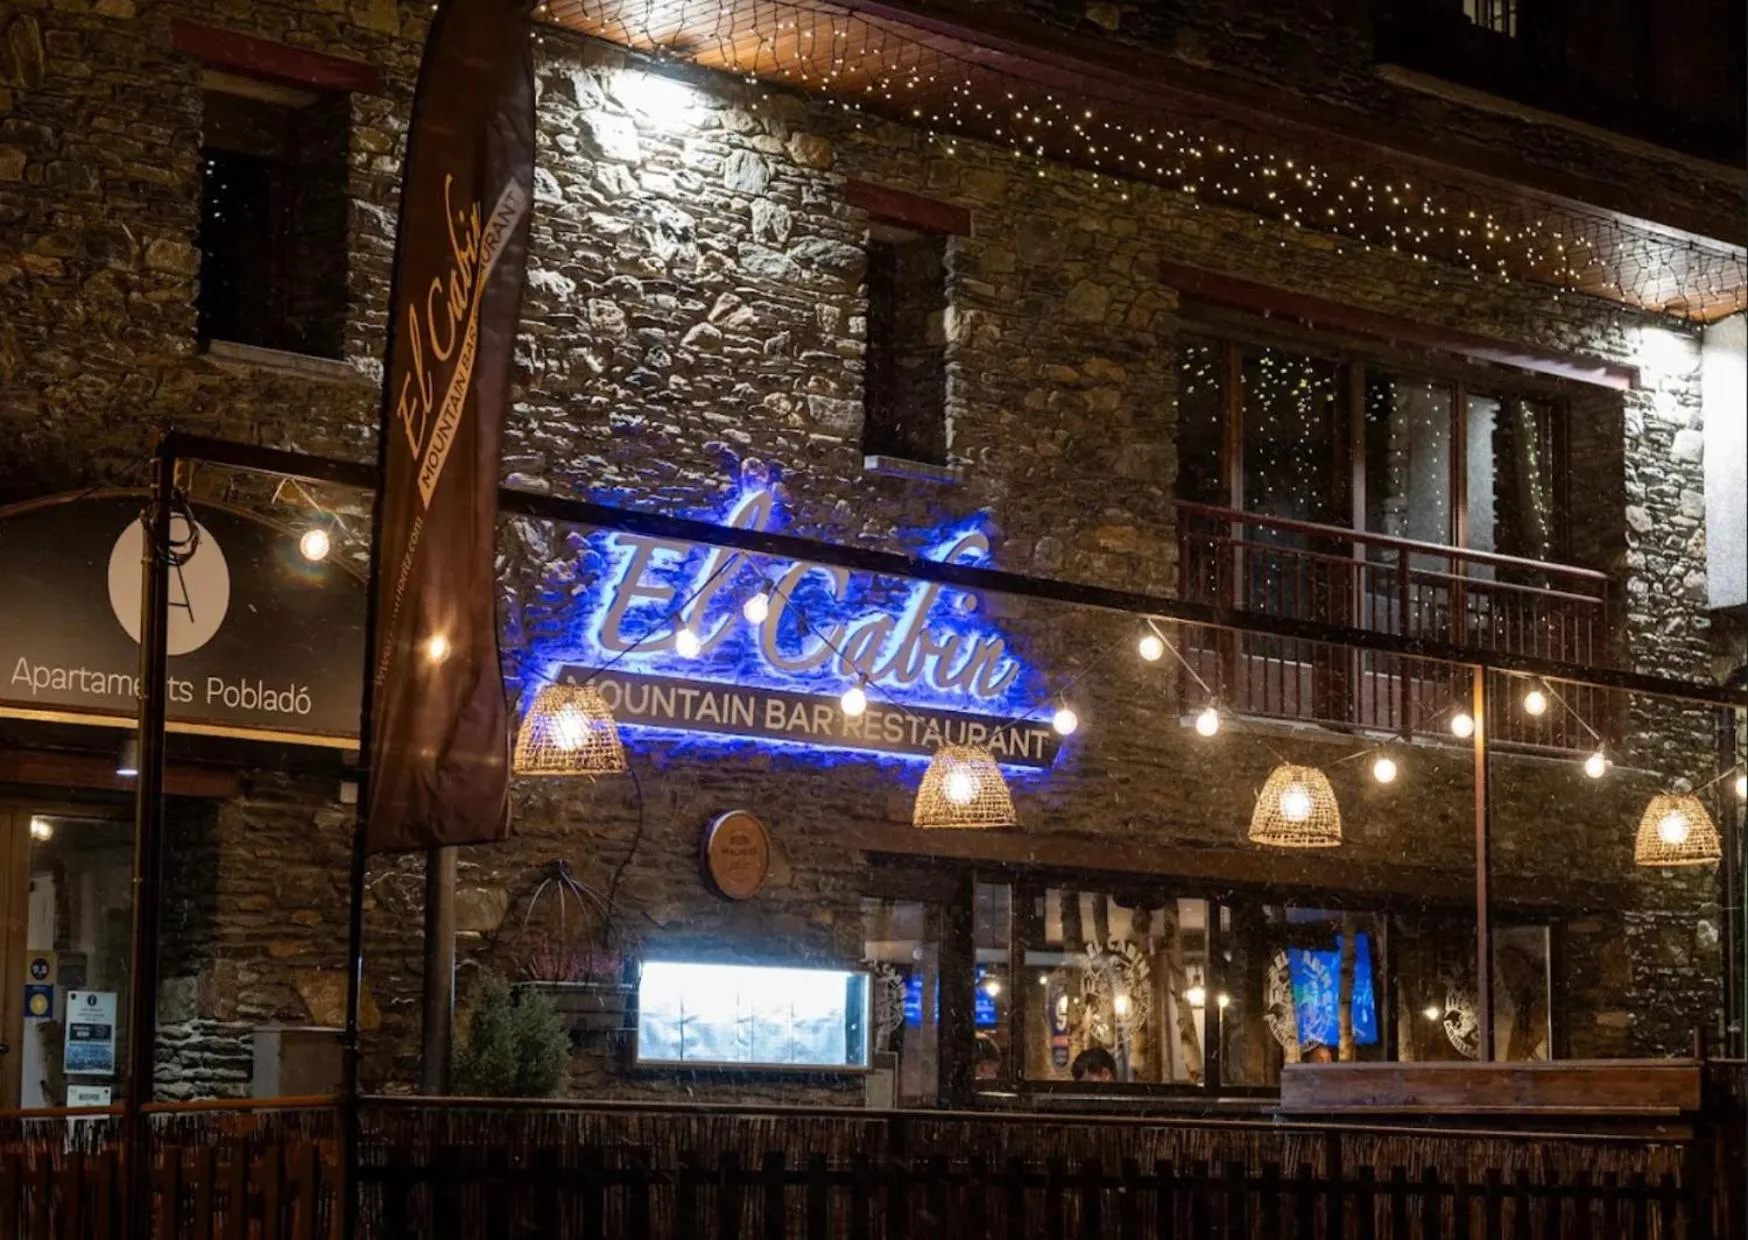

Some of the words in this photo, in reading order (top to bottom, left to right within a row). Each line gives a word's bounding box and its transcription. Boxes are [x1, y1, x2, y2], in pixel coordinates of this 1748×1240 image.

[397, 304, 433, 461] El
[421, 377, 467, 489] MOUNTAIN
[599, 490, 773, 656] El
[760, 533, 1021, 698] Cabin
[10, 656, 194, 703] Apartamts
[206, 676, 313, 715] Pobladó
[566, 675, 757, 735] OUNTAIN
[765, 699, 835, 736] BAR
[842, 709, 1050, 760] RESTAURANT
